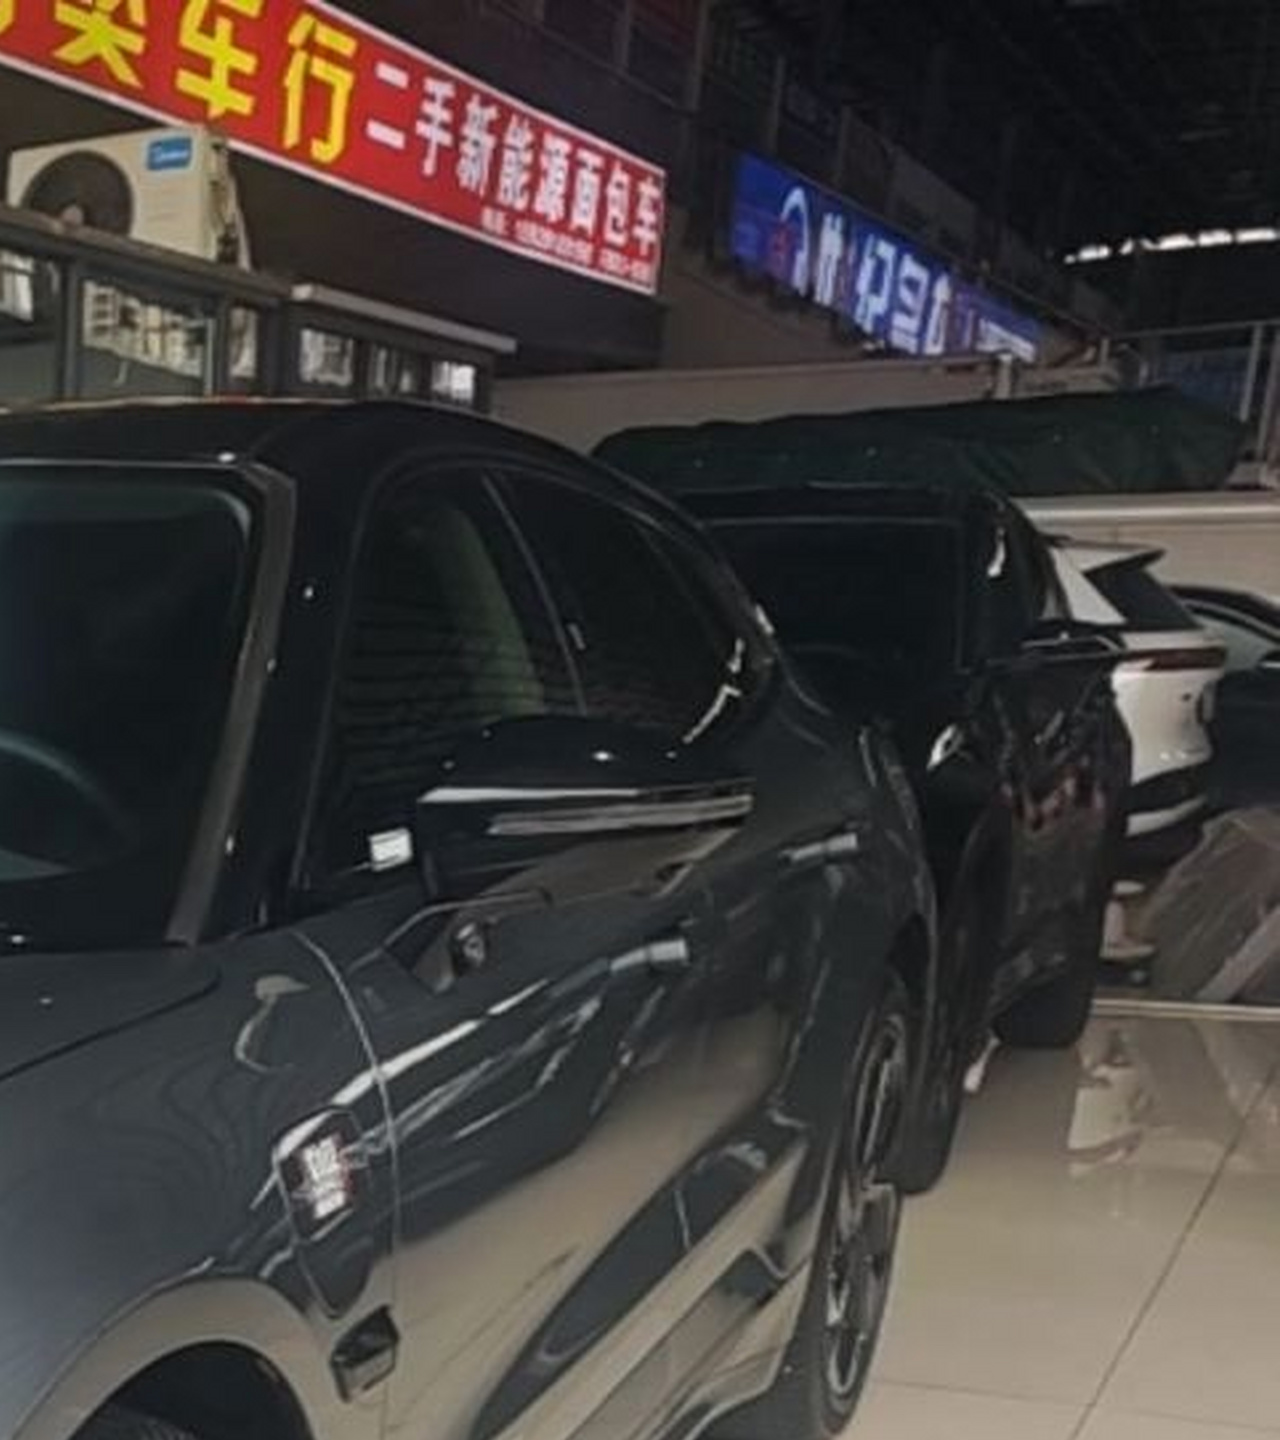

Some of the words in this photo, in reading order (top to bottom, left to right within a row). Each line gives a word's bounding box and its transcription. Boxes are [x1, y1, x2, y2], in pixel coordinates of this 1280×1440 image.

[366, 60, 661, 257] 二手新能源面包车
